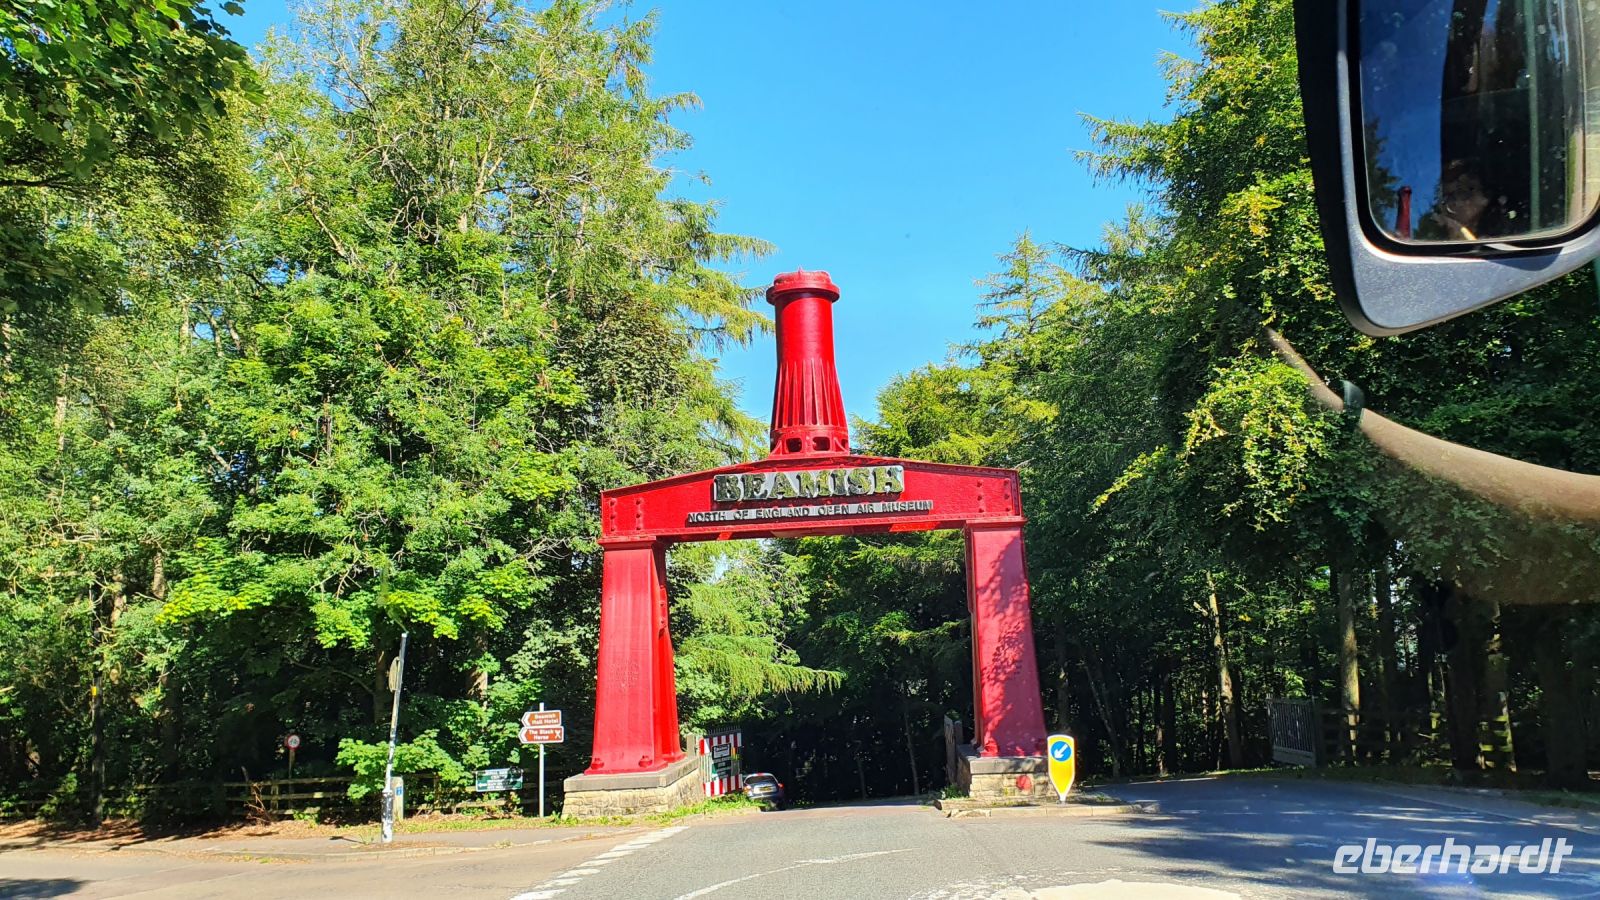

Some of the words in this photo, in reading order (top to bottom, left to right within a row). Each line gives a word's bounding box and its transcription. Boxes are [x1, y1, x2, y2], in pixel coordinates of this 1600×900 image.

[714, 465, 904, 501] BEAMISH
[687, 511, 726, 522] NORTH
[733, 510, 748, 520] OF
[755, 505, 810, 519] ENGLAND
[817, 504, 850, 516] OPEN
[856, 502, 875, 514] AIR
[881, 499, 933, 512] MUSEUM
